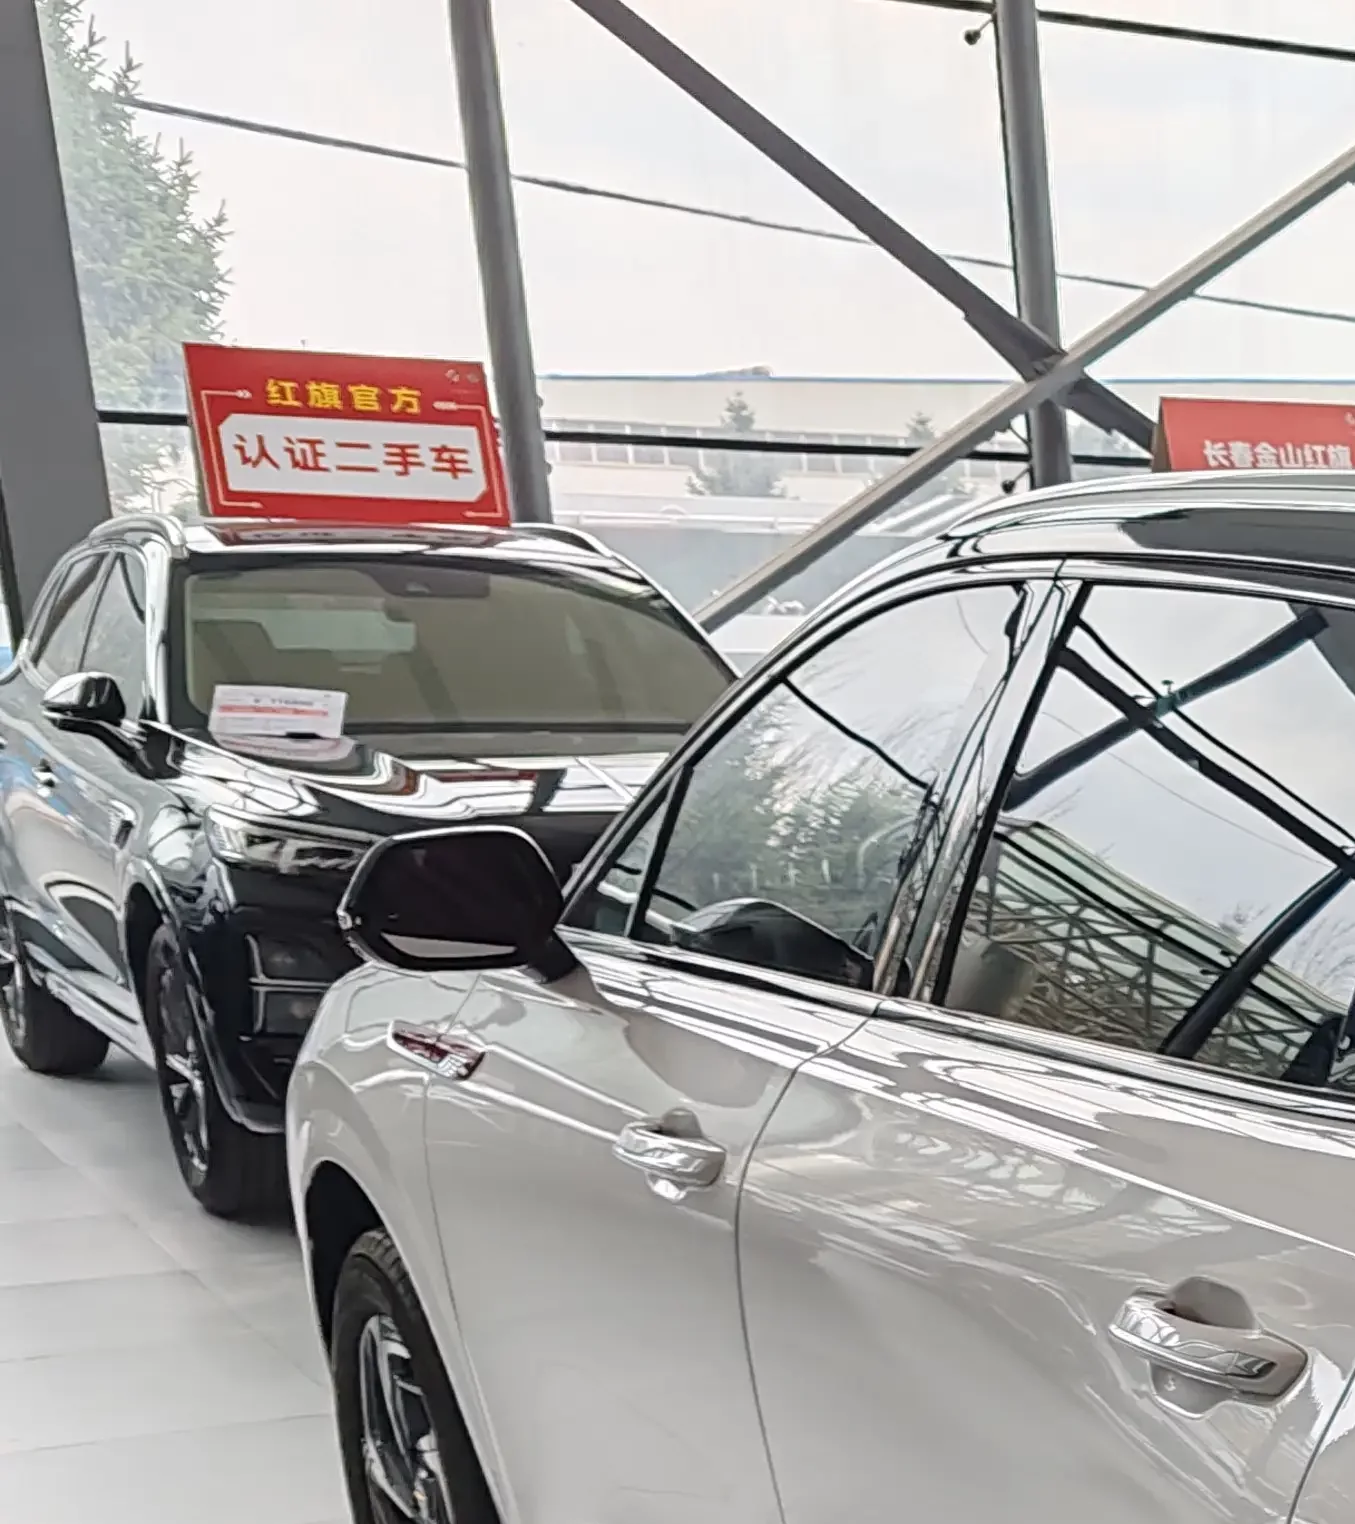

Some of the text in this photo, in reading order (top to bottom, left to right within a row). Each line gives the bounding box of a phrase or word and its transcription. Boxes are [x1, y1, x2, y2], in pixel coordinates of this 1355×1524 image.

[265, 378, 422, 415] 红旗官方
[233, 433, 474, 480] 认证二手车
[1203, 439, 1352, 468] 长春金山红旗
